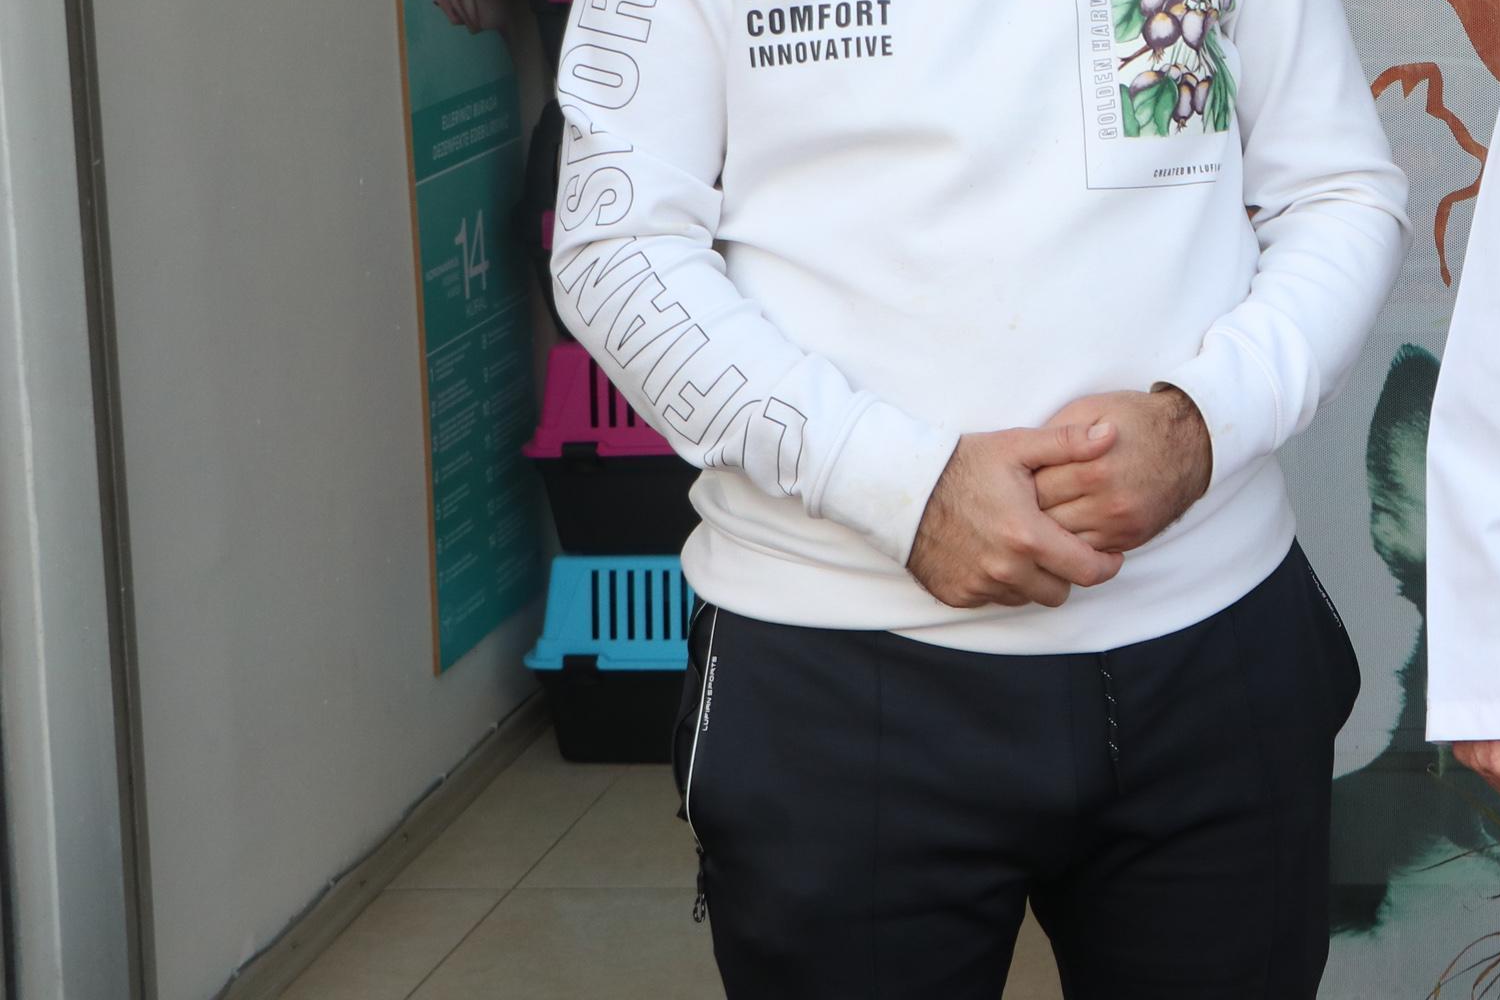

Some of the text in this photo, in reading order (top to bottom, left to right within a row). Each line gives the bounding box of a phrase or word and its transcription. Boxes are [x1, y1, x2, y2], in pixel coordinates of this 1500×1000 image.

[746, 0, 891, 37] COMFORT
[749, 35, 893, 68] INNOVATIVE
[1093, 57, 1118, 140] GOLDEN
[1153, 167, 1185, 178] CREATED
[1187, 166, 1197, 175] BY
[454, 209, 490, 299] 14
[707, 656, 717, 696] SPORTS
